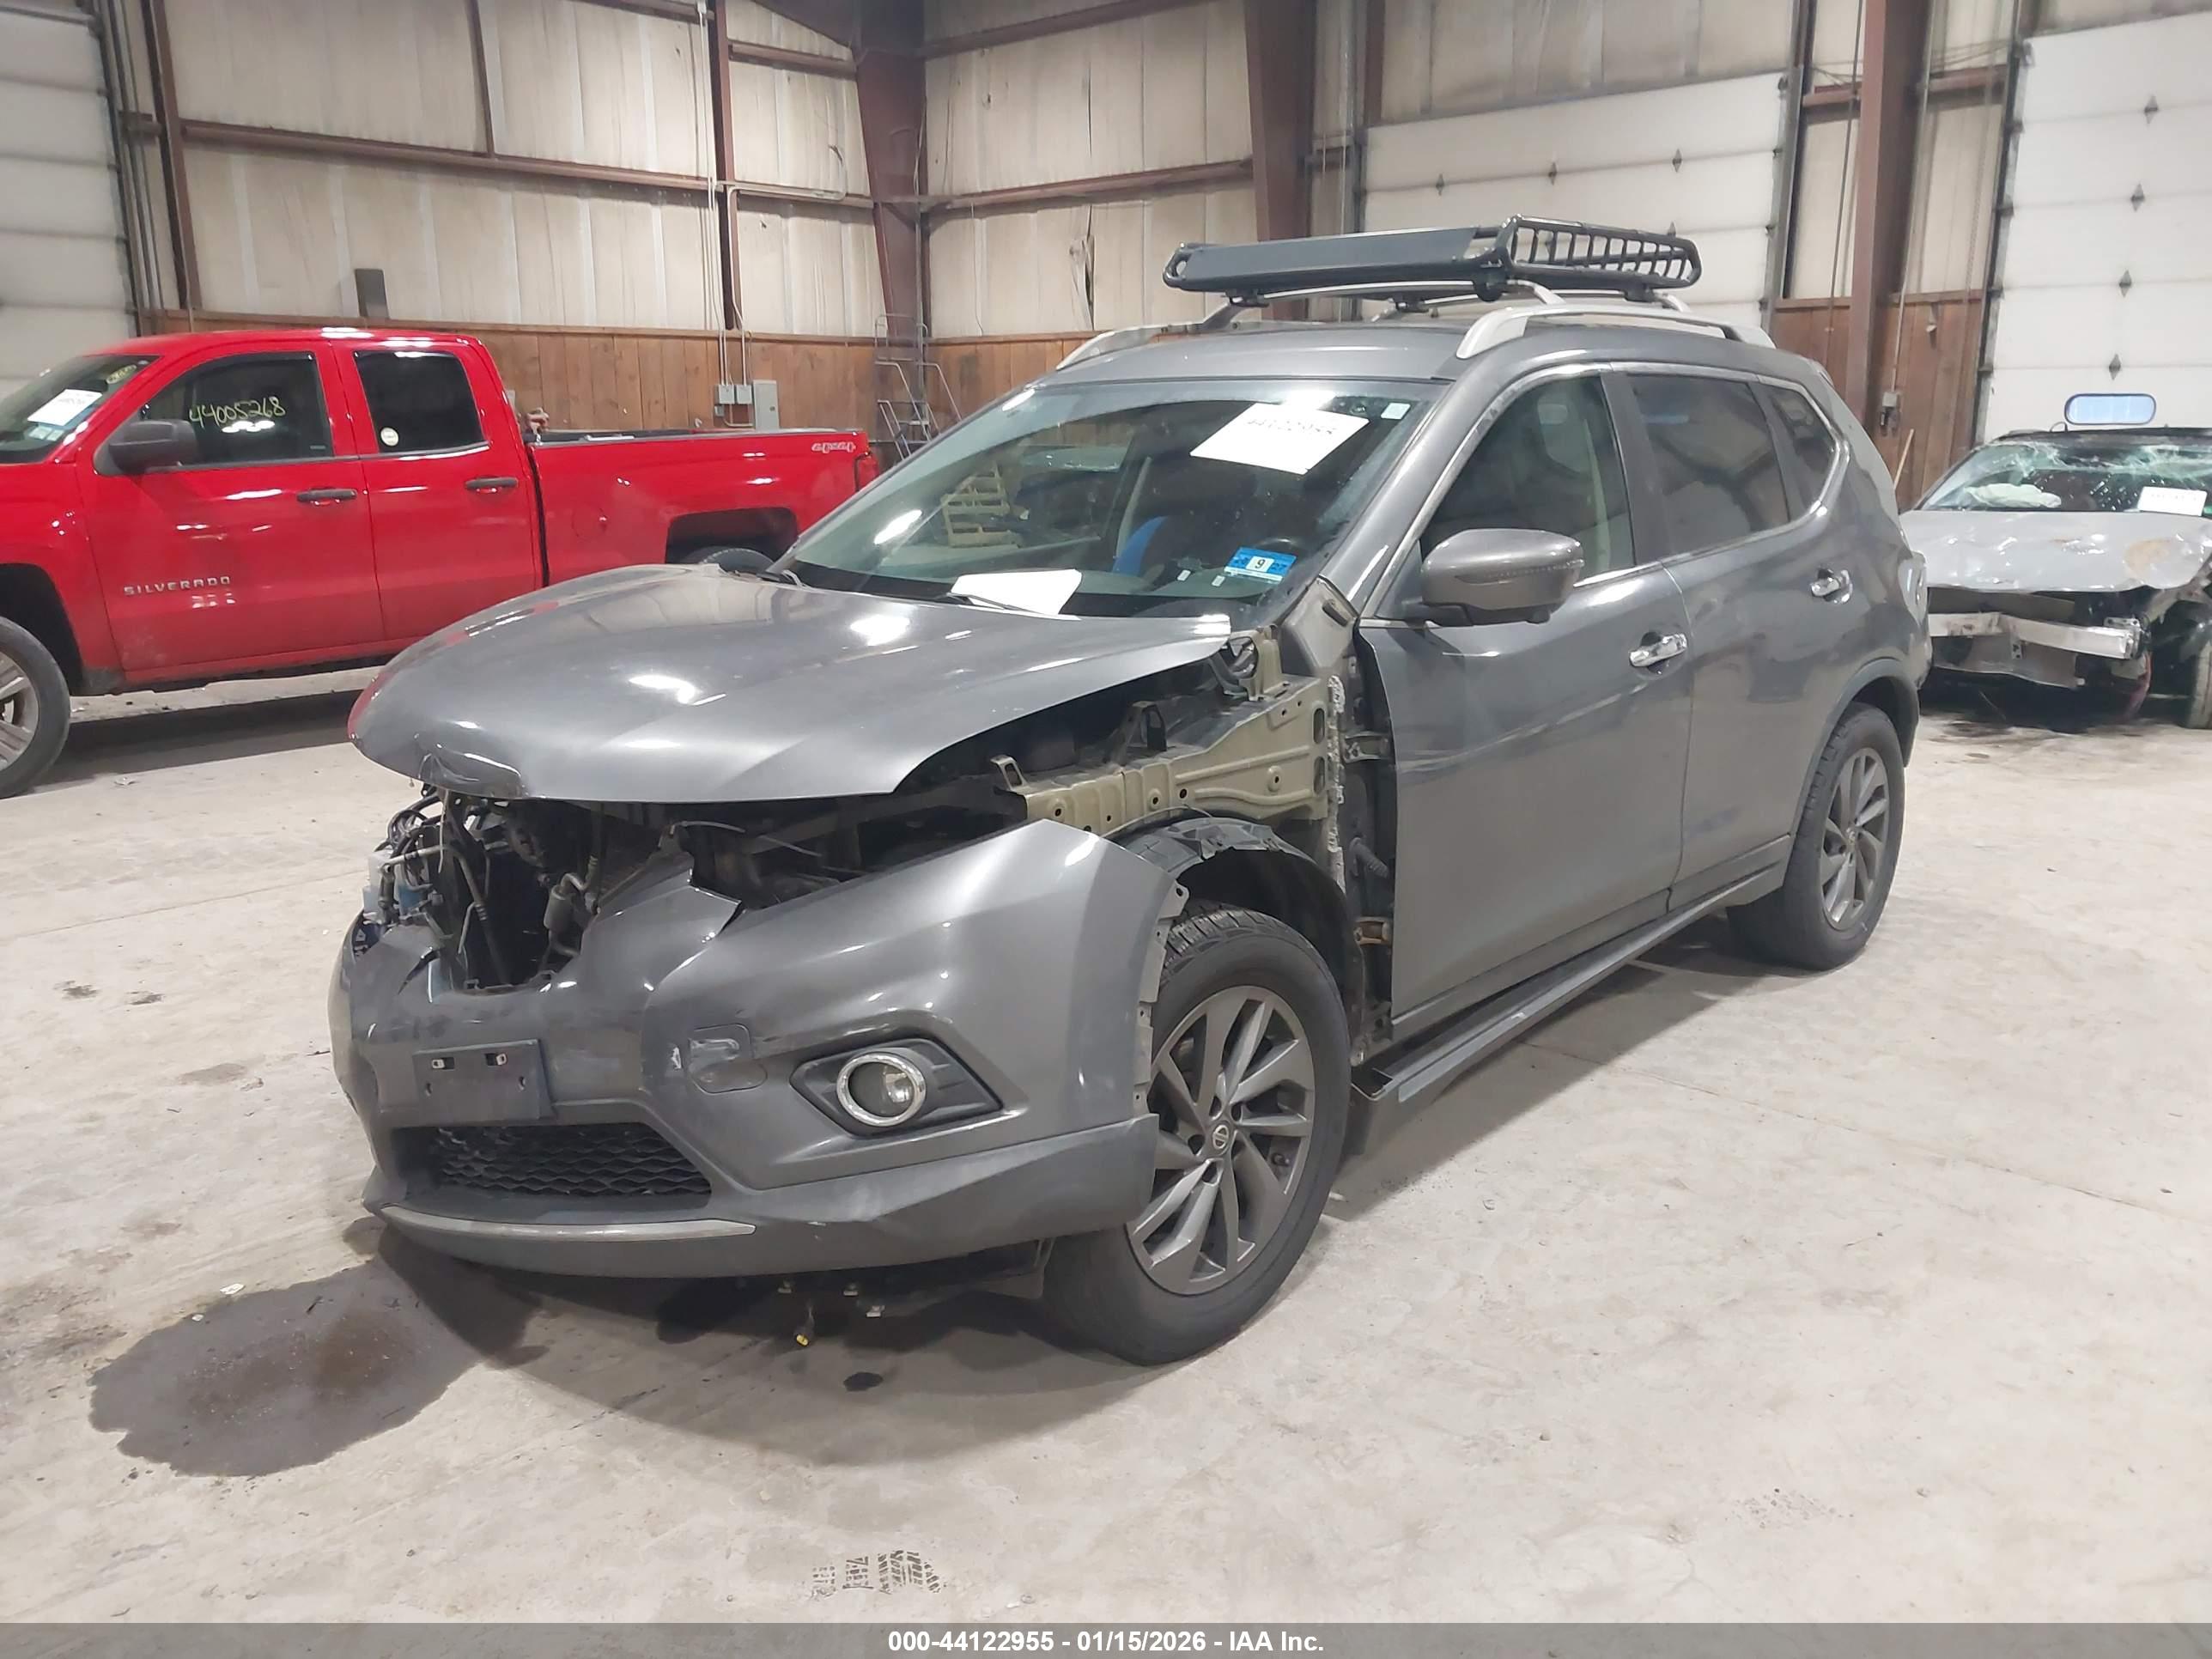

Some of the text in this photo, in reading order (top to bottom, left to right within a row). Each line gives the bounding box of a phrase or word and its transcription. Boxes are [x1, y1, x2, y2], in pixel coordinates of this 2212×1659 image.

[189, 396, 286, 428] 44005268
[1255, 558, 1266, 569] 9
[124, 576, 230, 595] SILVERADO
